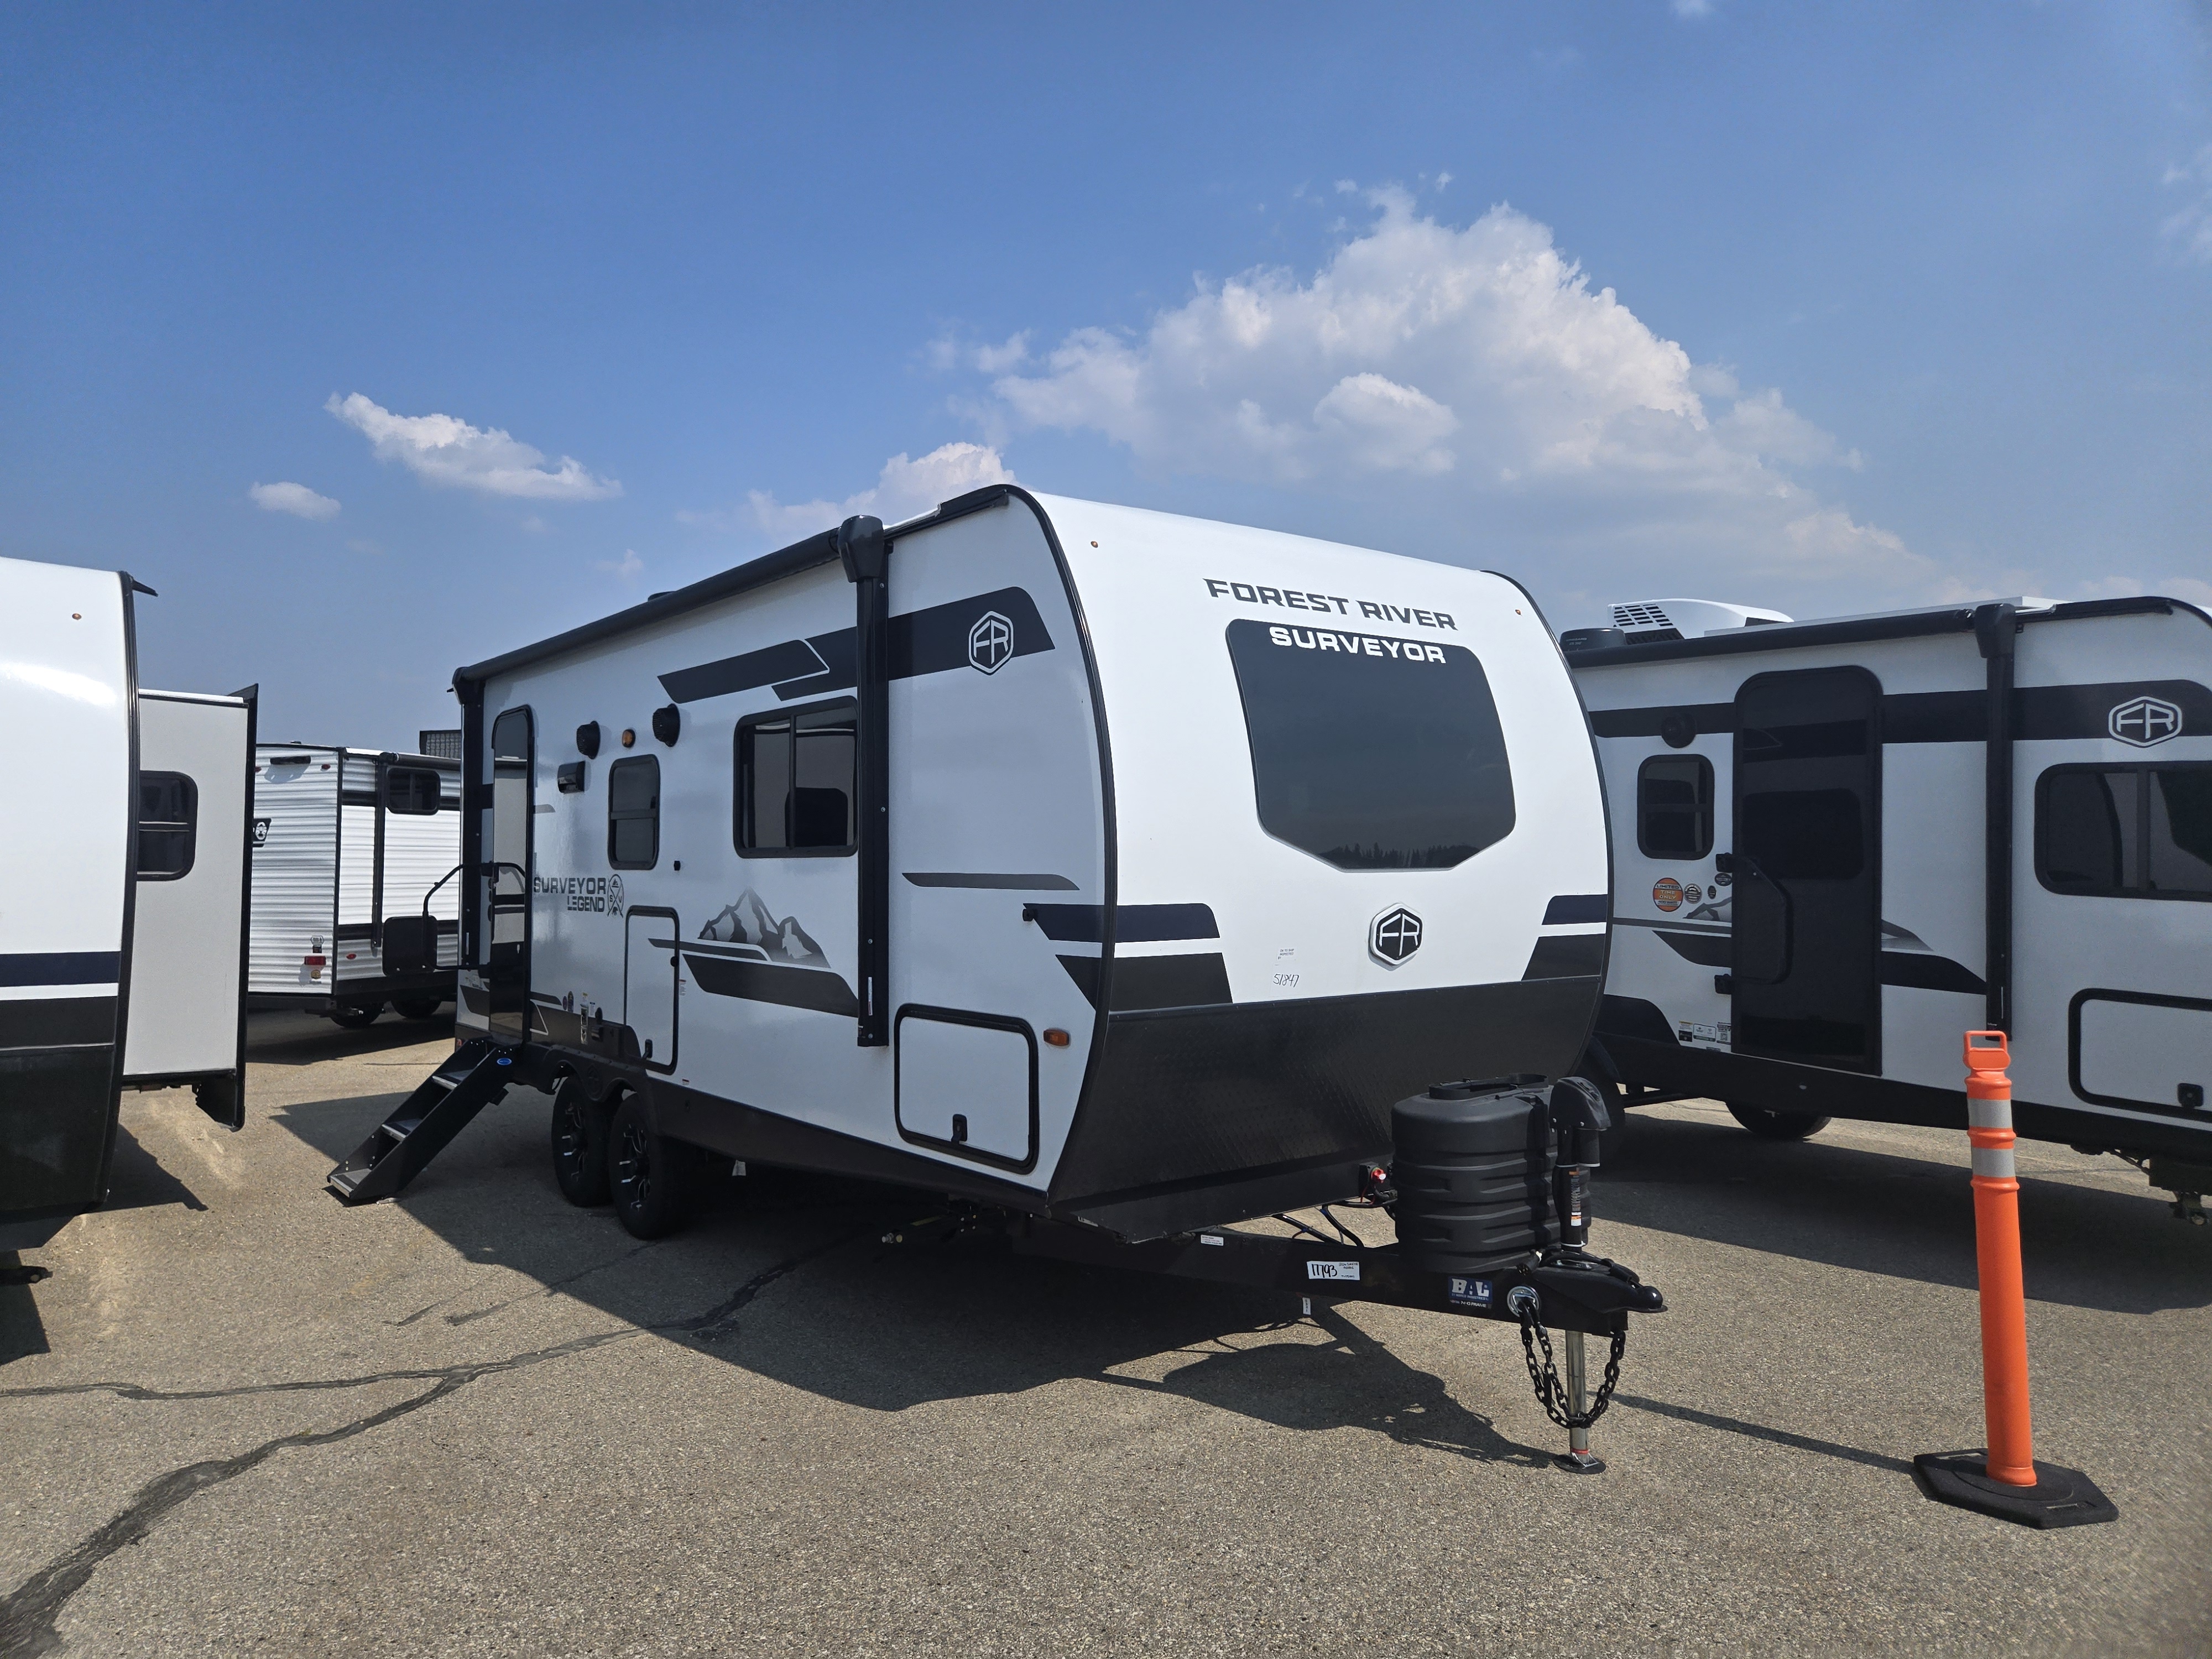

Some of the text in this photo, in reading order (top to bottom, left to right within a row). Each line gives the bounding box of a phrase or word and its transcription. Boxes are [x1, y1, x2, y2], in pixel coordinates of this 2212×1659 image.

[1202, 578, 1458, 630] FOREST RIVER
[1269, 627, 1447, 664] SURVEYOR
[534, 877, 606, 894] SURVEYOR
[567, 895, 604, 912] LEGEND
[1272, 973, 1300, 988] 51847
[1452, 1279, 1489, 1297] BAL
